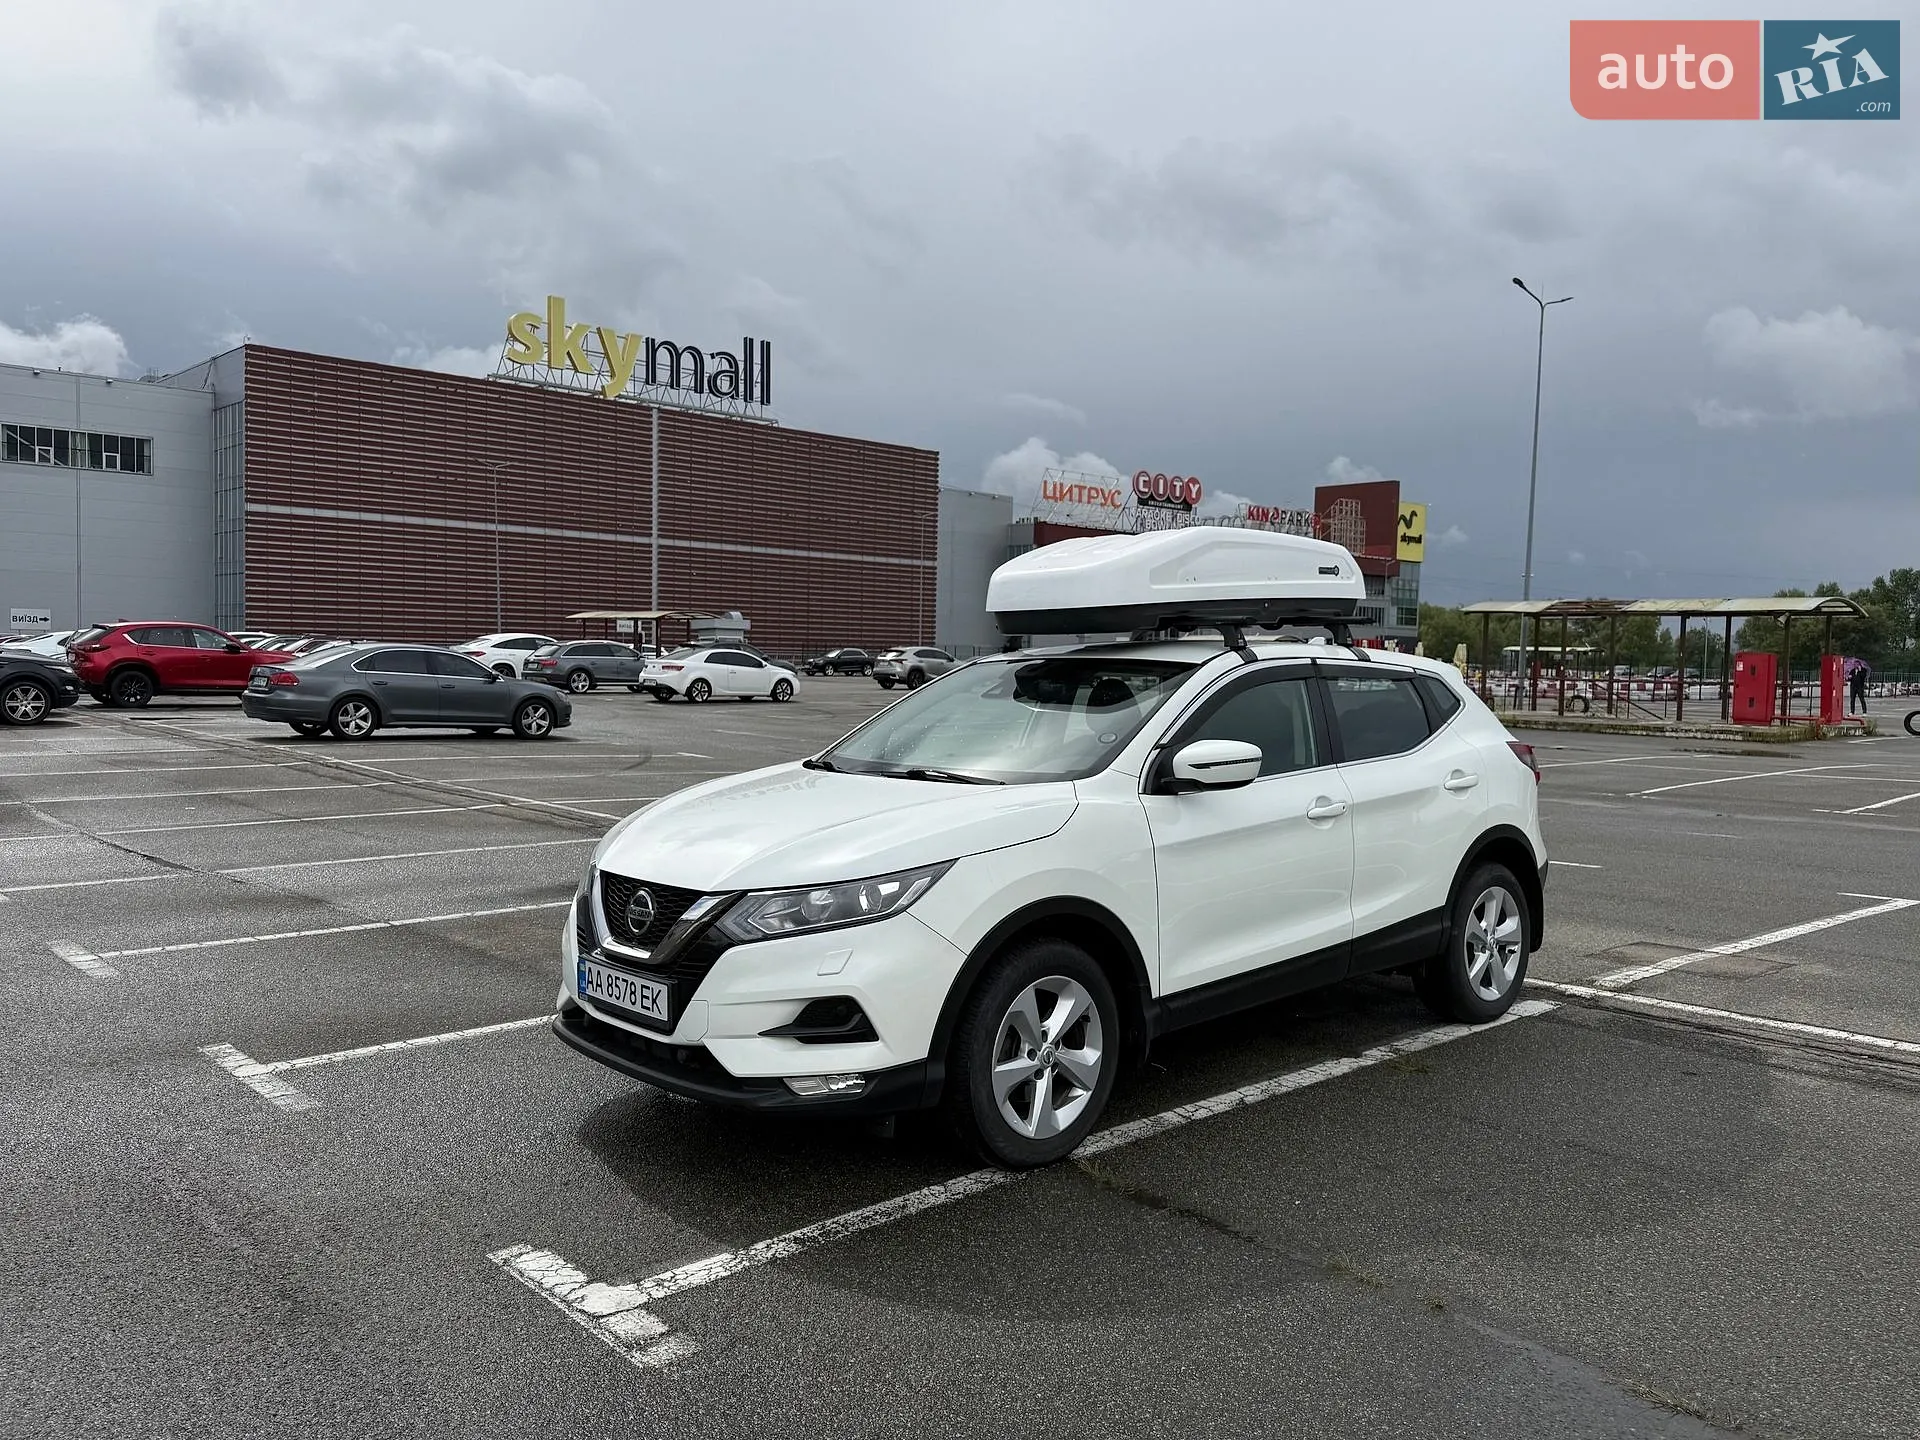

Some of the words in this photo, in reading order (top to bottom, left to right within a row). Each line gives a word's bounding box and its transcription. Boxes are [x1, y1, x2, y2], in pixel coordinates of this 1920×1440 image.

[1042, 480, 1122, 509] ЦИТРУС
[1136, 472, 1201, 500] CITY
[12, 614, 39, 624] ВИЇЗД
[606, 973, 637, 1006] 8578
[640, 983, 663, 1015] EK
